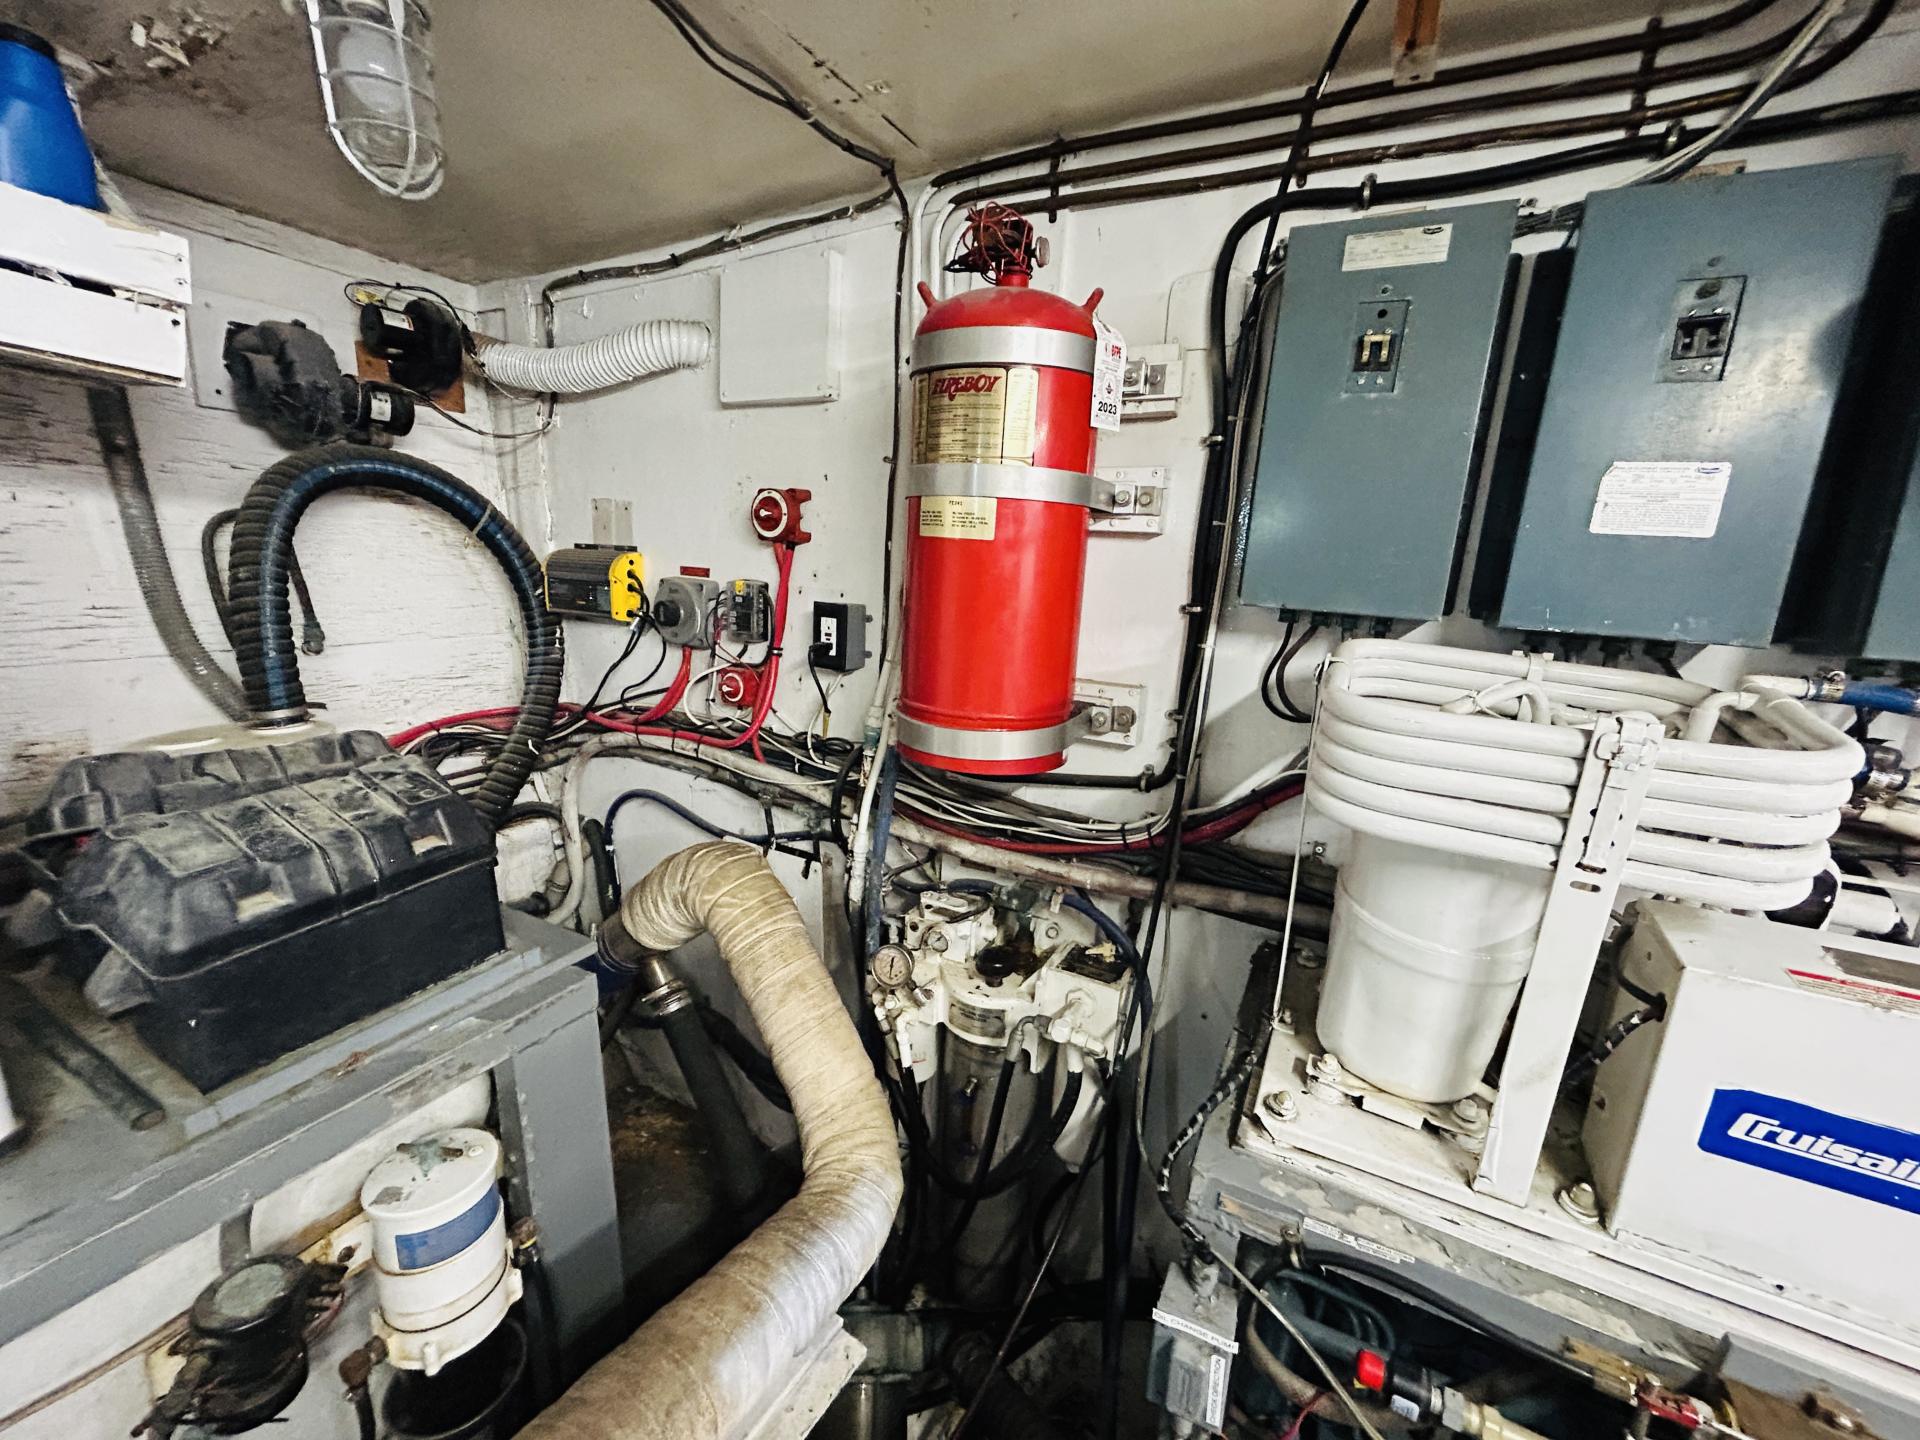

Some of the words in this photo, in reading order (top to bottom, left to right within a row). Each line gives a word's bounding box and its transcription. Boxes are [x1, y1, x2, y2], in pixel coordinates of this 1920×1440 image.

[931, 374, 1002, 401] FIREBOY
[1098, 401, 1117, 415] 2023
[1170, 1319, 1209, 1338] CHANGE
